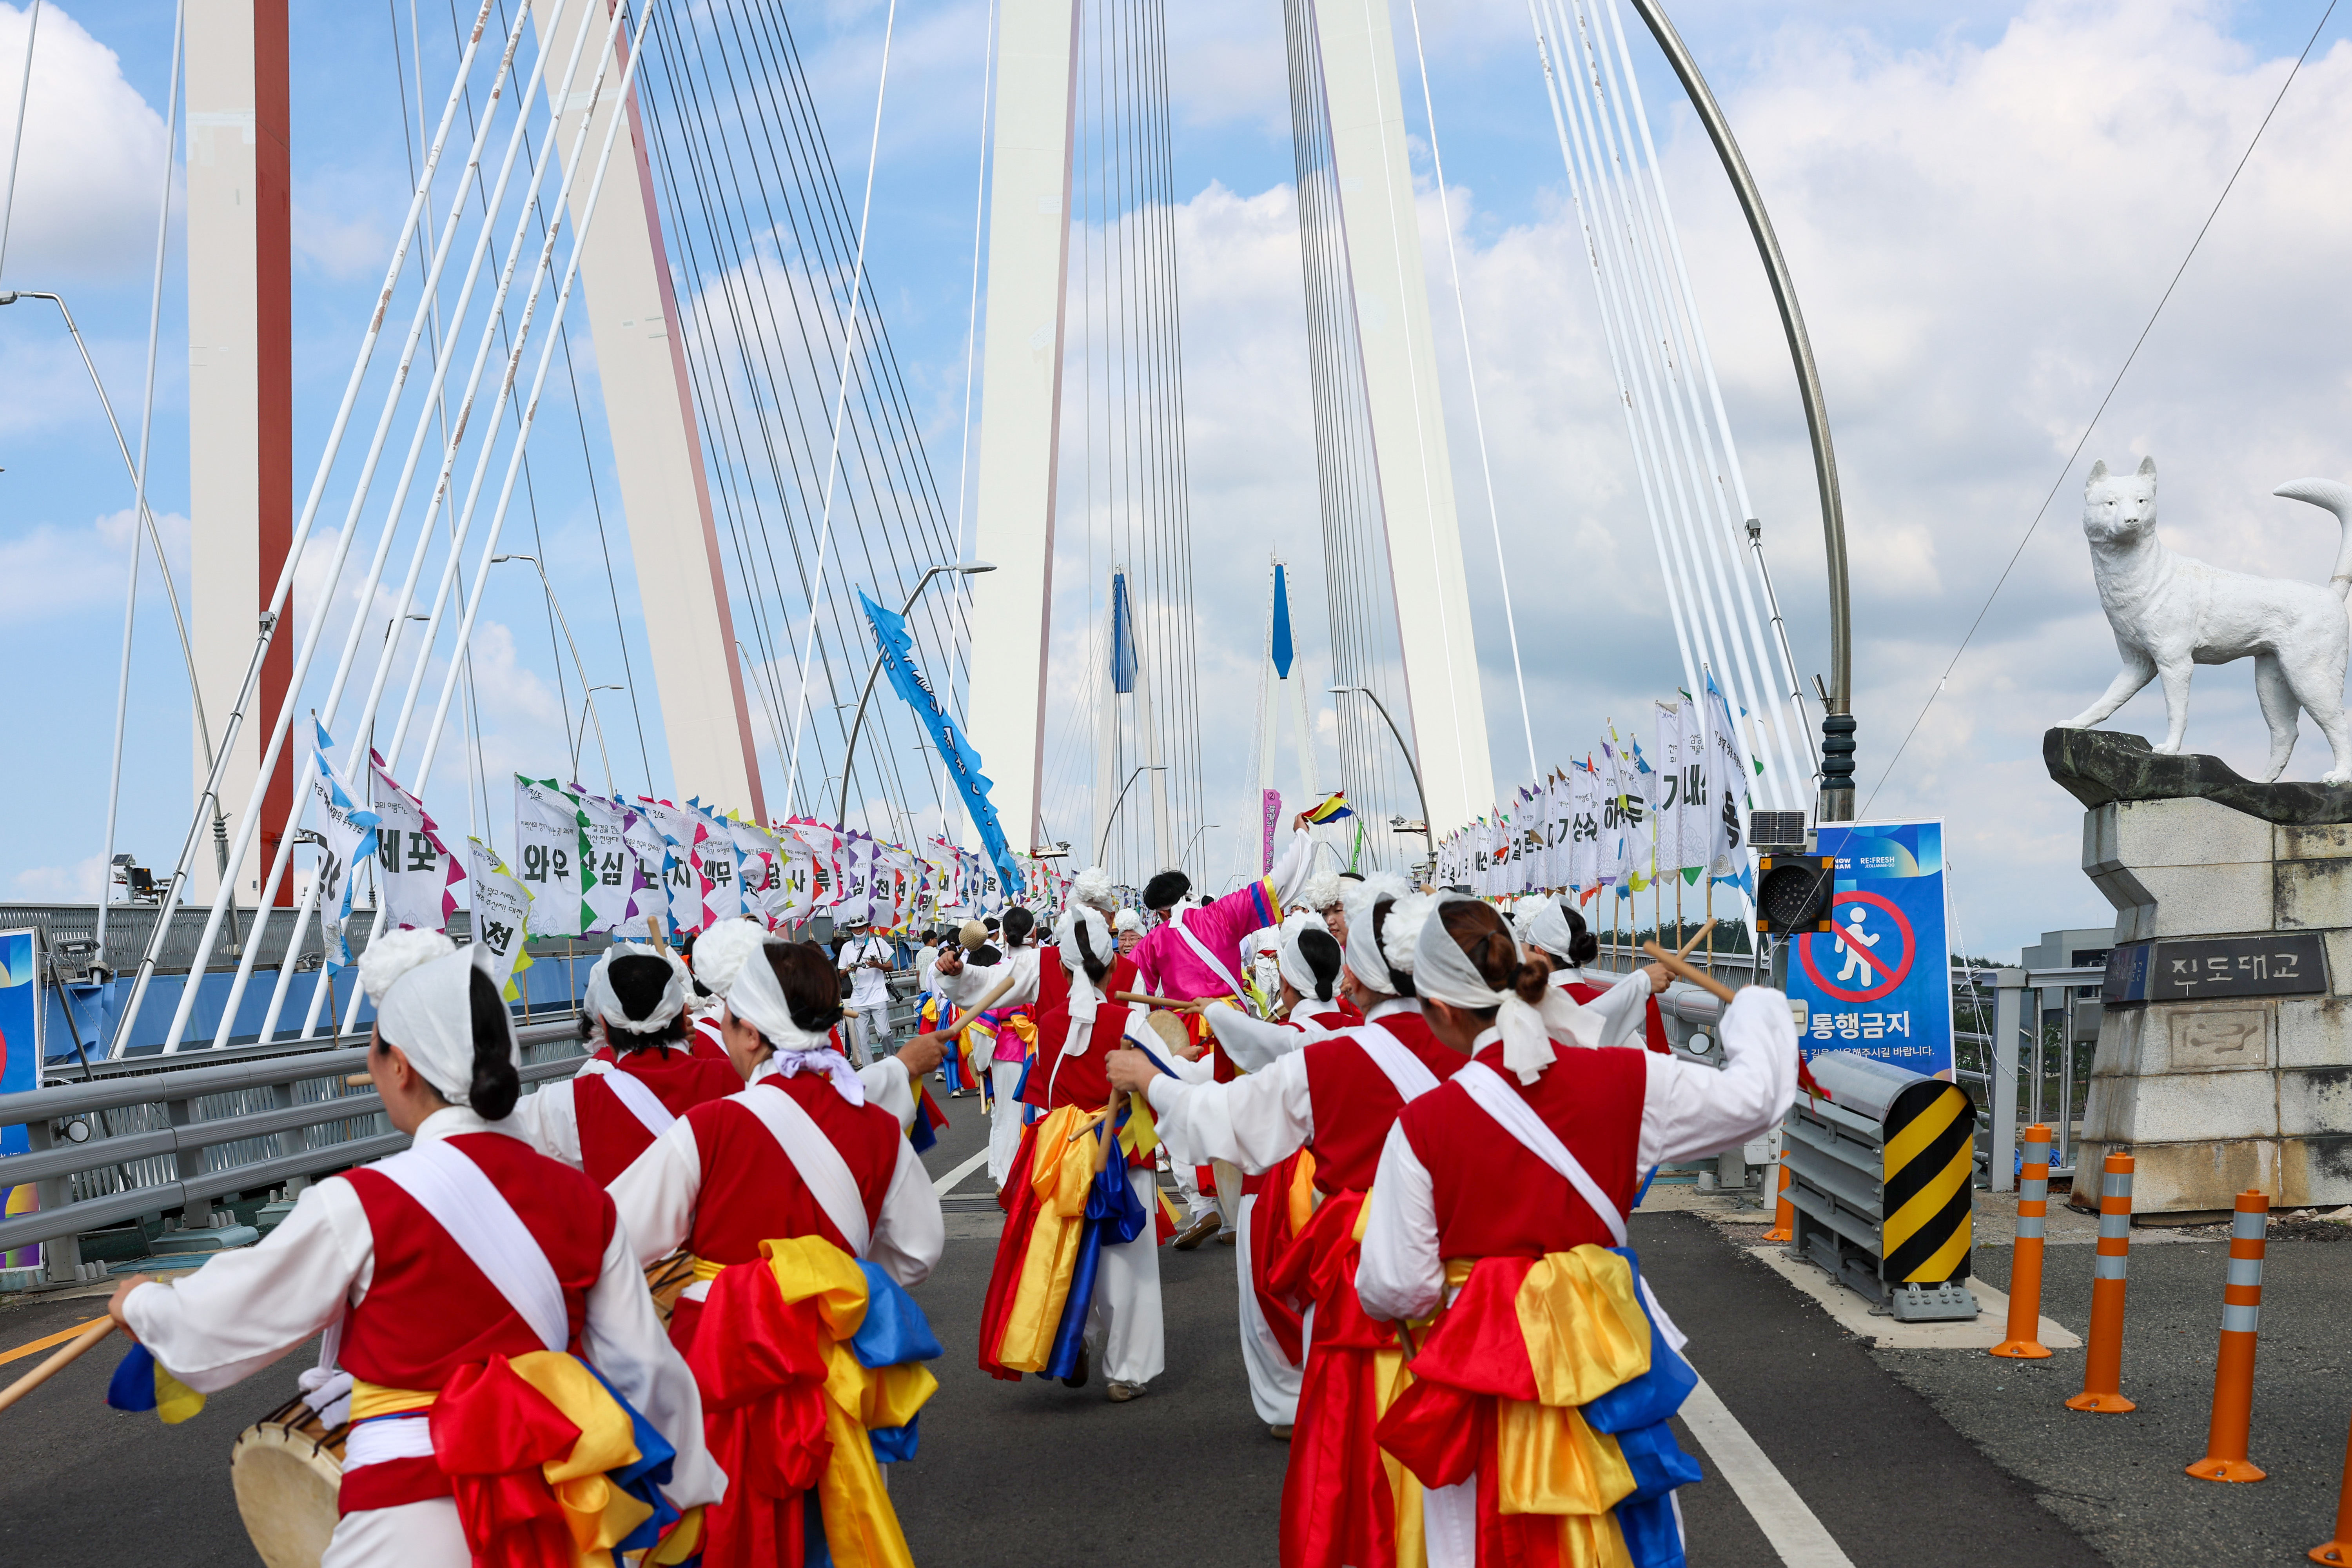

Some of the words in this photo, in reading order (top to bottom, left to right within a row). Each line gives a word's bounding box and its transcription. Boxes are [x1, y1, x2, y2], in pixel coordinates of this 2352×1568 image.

[652, 809, 667, 819] 진도
[592, 824, 608, 833] 절경을
[599, 835, 619, 845] 전망대
[636, 840, 647, 849] 한국의
[648, 843, 660, 853] 알프스!
[377, 829, 437, 873] 세포
[524, 844, 569, 884] 와우
[1860, 856, 1895, 864] RE:FRESH
[487, 887, 498, 897] 맞고
[500, 891, 516, 904] 자라는
[876, 878, 889, 900] 천
[486, 898, 506, 912] 주산지!
[508, 906, 523, 918] 대천
[2172, 953, 2300, 986] 진도대교
[1810, 1011, 1910, 1040] 통행금지
[1893, 1045, 1935, 1057] 바랍니다.
